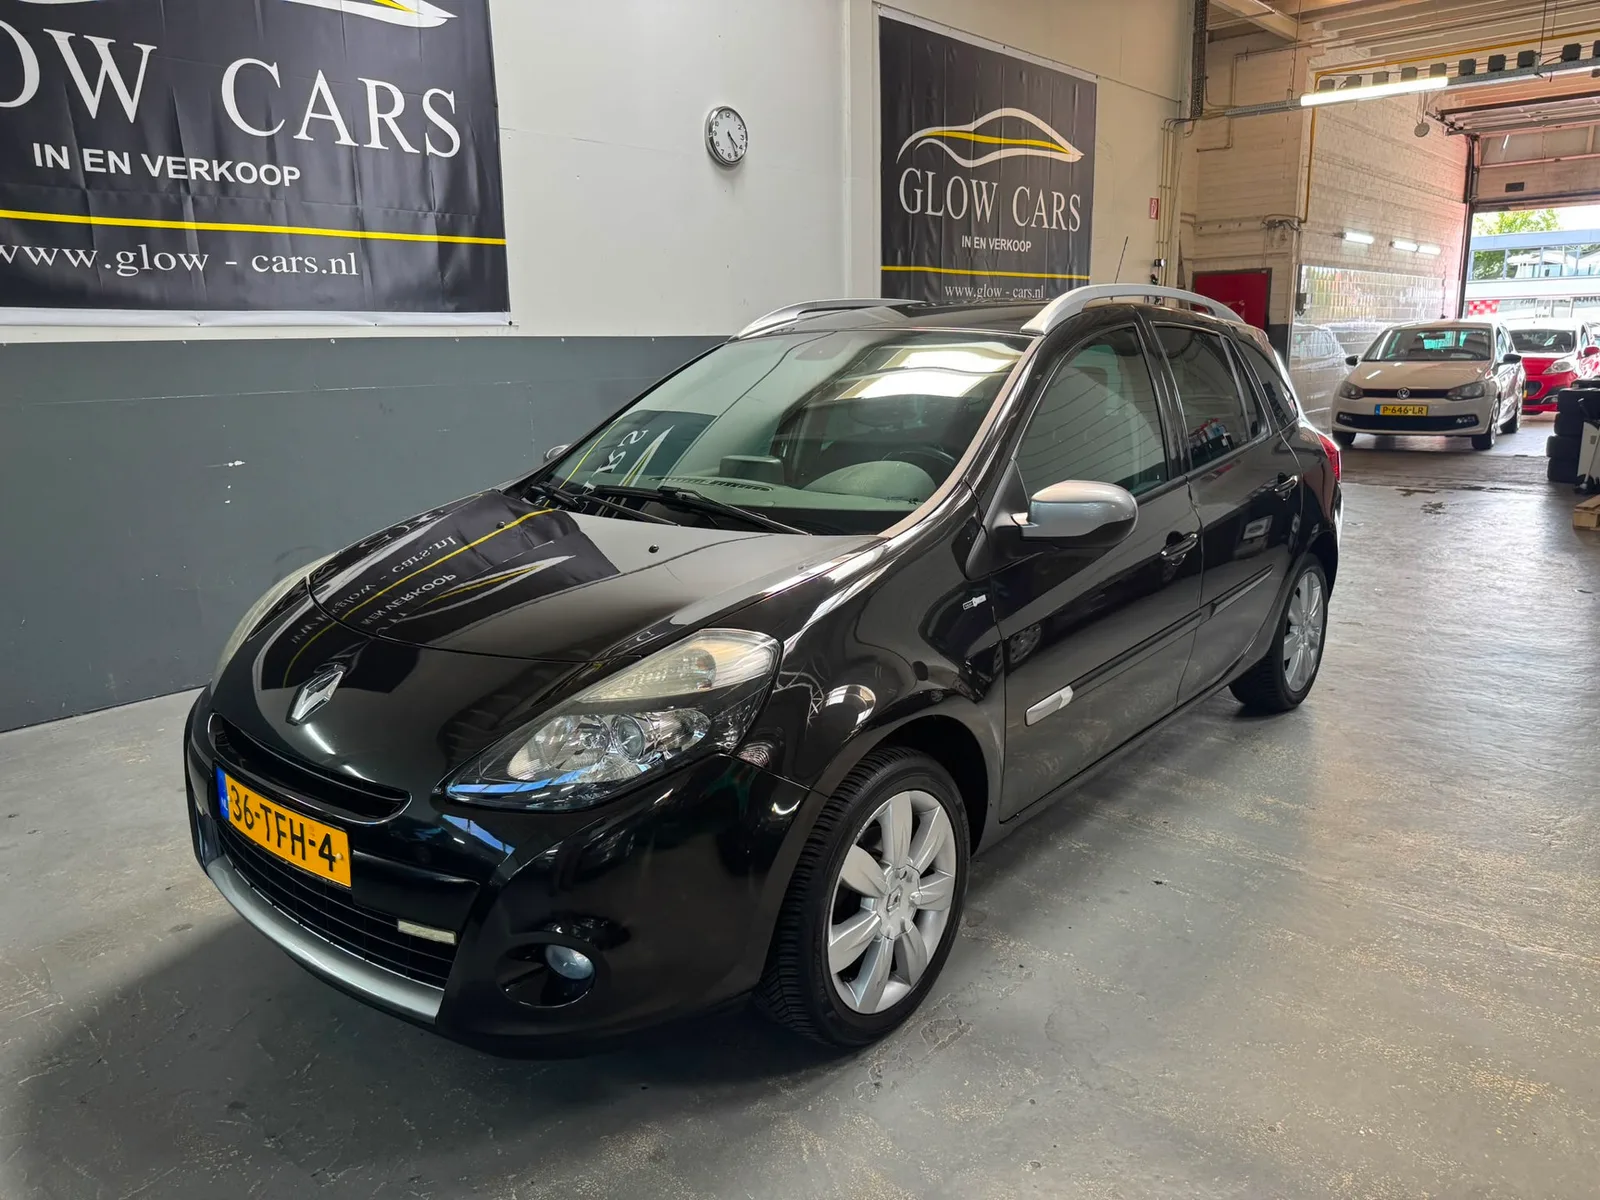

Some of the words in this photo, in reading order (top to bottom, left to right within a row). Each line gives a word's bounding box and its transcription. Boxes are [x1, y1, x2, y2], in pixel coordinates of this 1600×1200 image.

[221, 57, 461, 158] CARS
[32, 142, 70, 170] IN
[82, 148, 132, 176] EN
[141, 153, 301, 188] VERKOOP
[899, 167, 998, 224] GLOW
[1012, 185, 1081, 233] CARS
[961, 235, 972, 248] IN
[974, 236, 987, 250] EN
[989, 237, 1032, 253] VERKOOP
[251, 251, 360, 277] cars.nl
[944, 284, 1003, 300] www.glow
[1012, 285, 1044, 299] cars.nl
[1382, 406, 1424, 415] P-646-LR
[230, 784, 337, 873] 36-TFH-4
